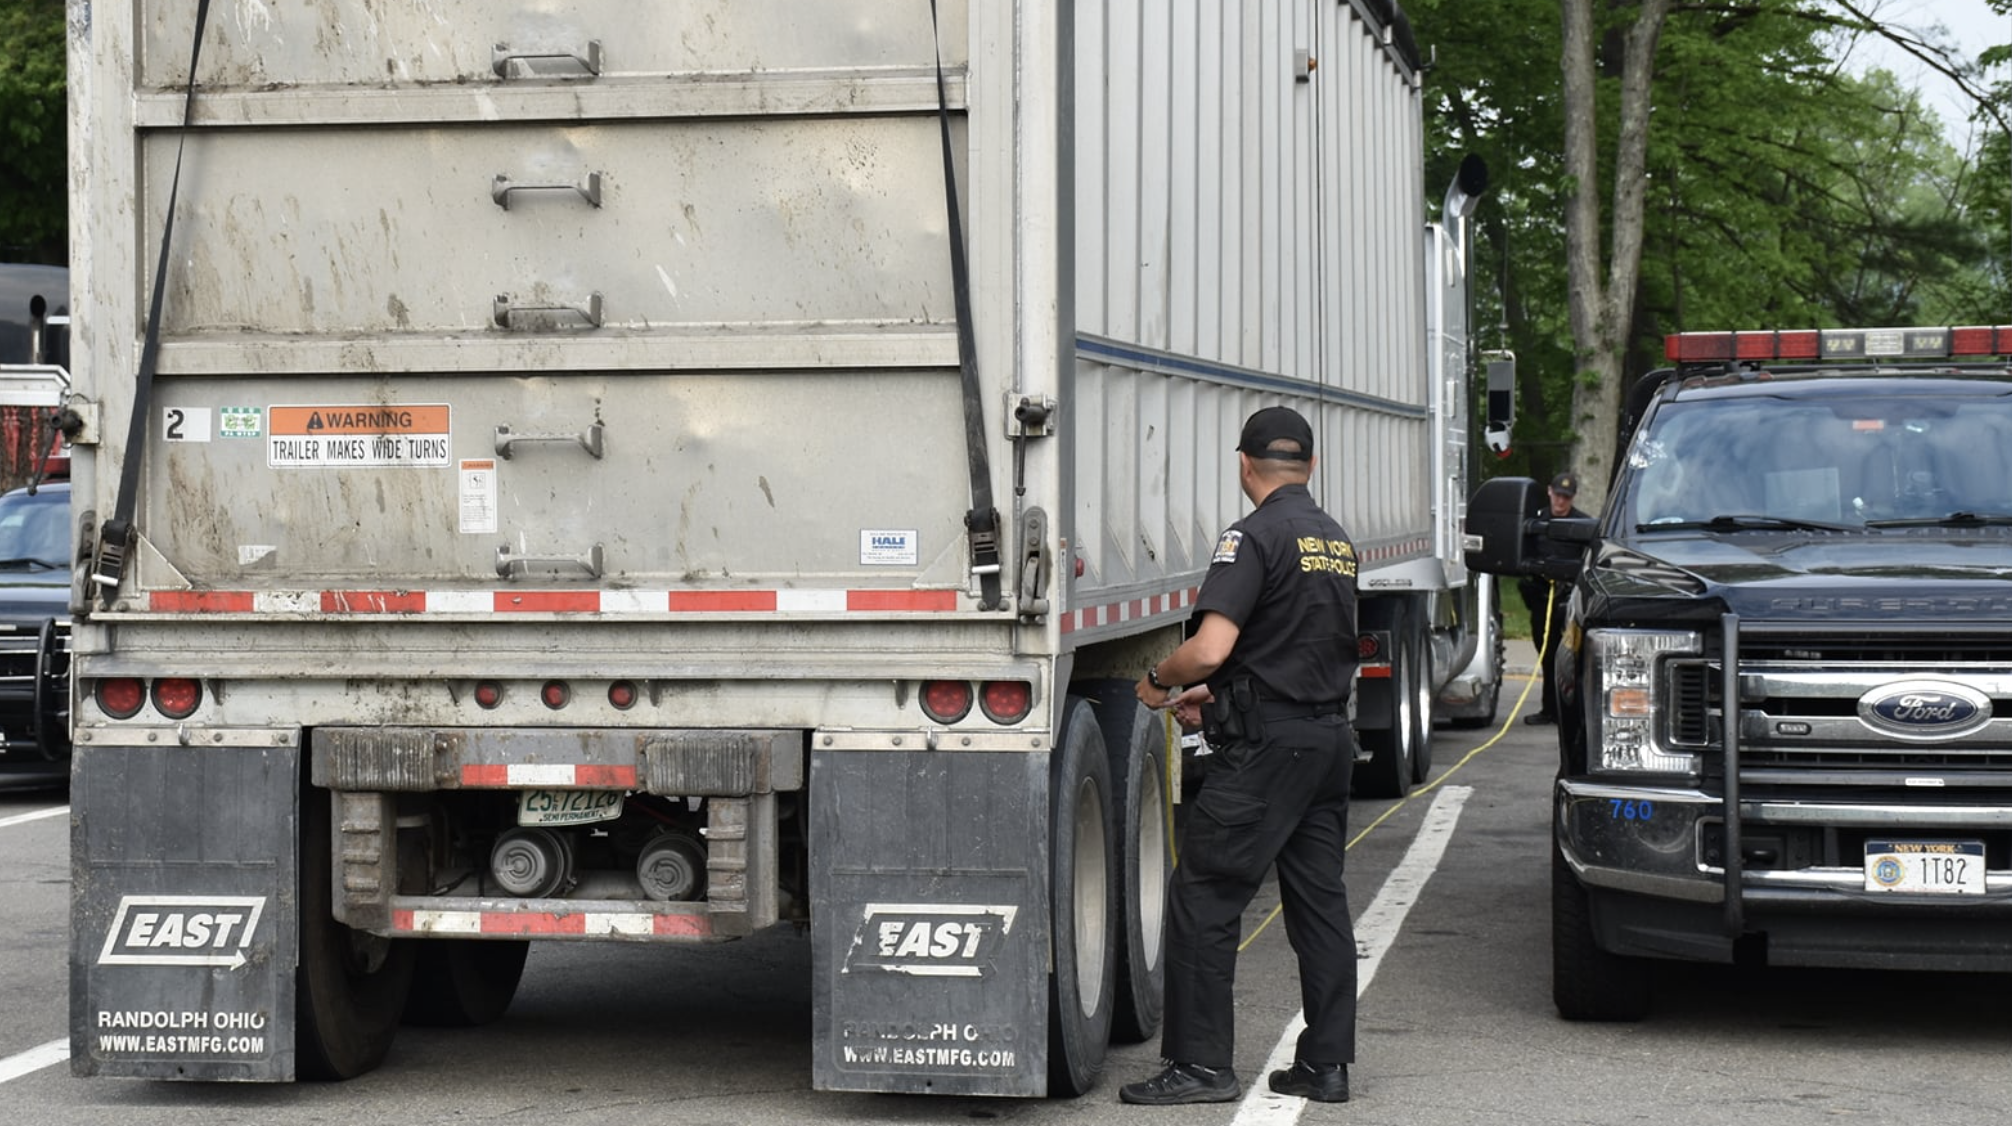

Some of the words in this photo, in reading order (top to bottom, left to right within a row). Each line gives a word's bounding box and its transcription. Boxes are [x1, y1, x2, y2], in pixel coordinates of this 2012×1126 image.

[167, 410, 184, 439] 2
[326, 412, 413, 428] WARNING
[273, 440, 320, 460] TRAILER
[326, 440, 365, 460] MAKES
[372, 439, 402, 459] WIDE
[408, 439, 447, 459] TURNS
[872, 537, 905, 545] HALE
[1297, 537, 1326, 554] NEW
[1326, 540, 1354, 559] YORK
[1893, 695, 1957, 719] Ford
[526, 790, 552, 811] 25
[1609, 799, 1654, 820] 760
[1894, 844, 1923, 853] NEW
[1925, 844, 1956, 853] YORK
[1921, 858, 1967, 884] 1T82
[125, 913, 243, 948] EAST
[878, 922, 984, 958] EAST
[98, 1011, 208, 1028] RANDOLPH
[213, 1012, 265, 1029] OHIO
[99, 1036, 264, 1053] WWW.EASTMFG.COM
[843, 1046, 1015, 1067] WWW.EASTMFG.COM
